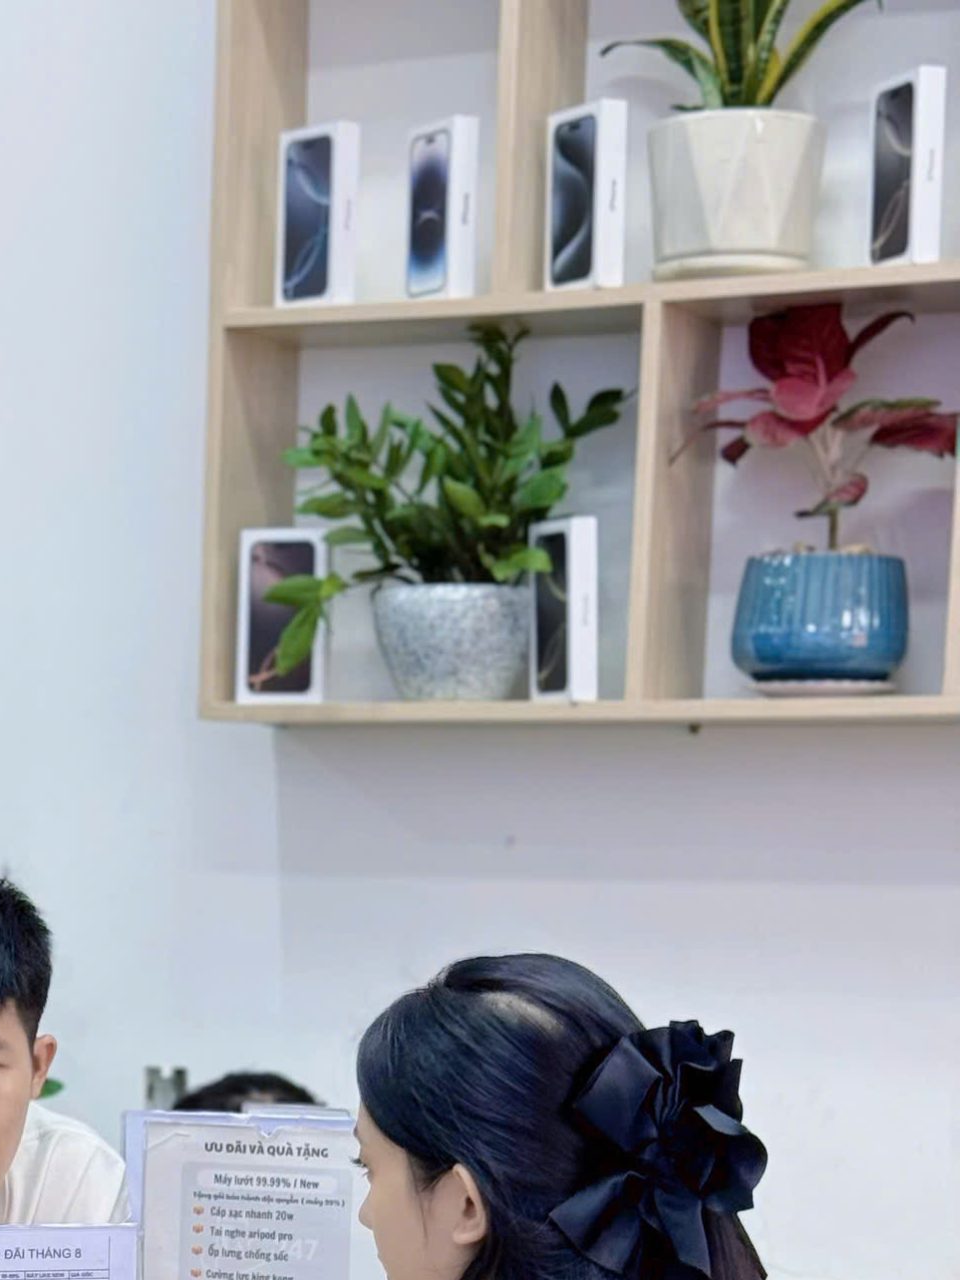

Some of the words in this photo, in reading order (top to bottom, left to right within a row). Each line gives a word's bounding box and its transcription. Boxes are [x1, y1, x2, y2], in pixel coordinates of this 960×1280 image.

[205, 1141, 223, 1153] ƯU
[226, 1141, 246, 1154] ĐÃI
[248, 1140, 264, 1155] VÀ
[268, 1141, 293, 1156] QUÀ
[296, 1146, 328, 1160] TẶNG
[214, 1173, 232, 1186] Máy
[235, 1174, 253, 1186] lướt
[256, 1175, 291, 1189] 99.99%
[300, 1178, 319, 1189] New
[210, 1206, 226, 1218] Cáp
[245, 1210, 272, 1219] nhanh
[210, 1226, 222, 1236] Tai
[225, 1228, 245, 1239] nghe
[248, 1229, 276, 1240] aripod
[278, 1232, 293, 1241] pro
[4, 1247, 24, 1259] ĐÃI
[28, 1246, 71, 1259] THÁNG
[75, 1248, 81, 1258] 8
[208, 1244, 219, 1256] Ốp
[245, 1248, 271, 1262] chống
[273, 1248, 288, 1261] sốc
